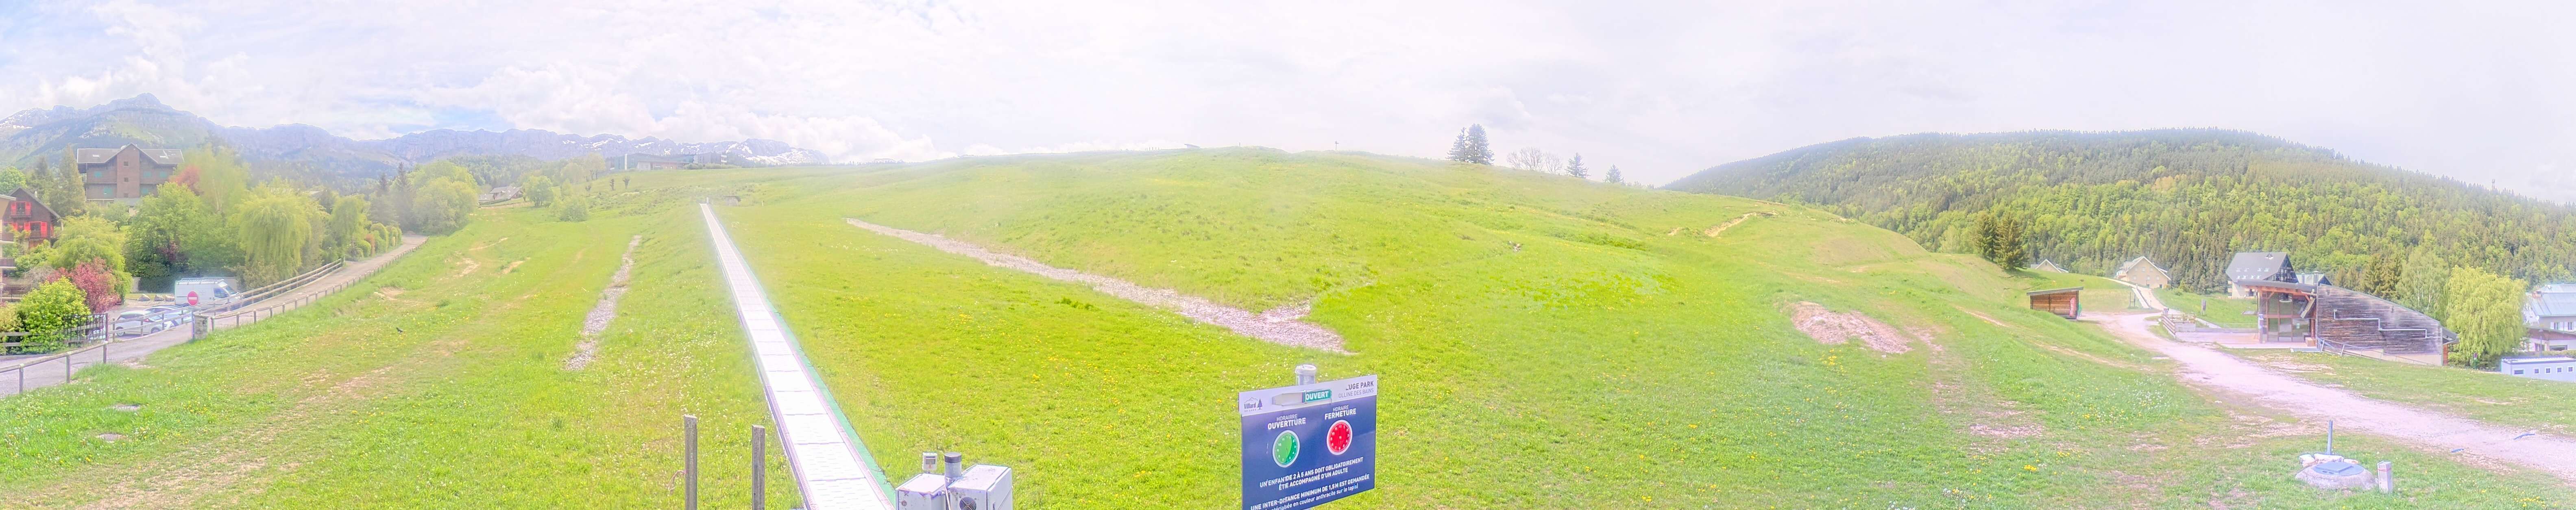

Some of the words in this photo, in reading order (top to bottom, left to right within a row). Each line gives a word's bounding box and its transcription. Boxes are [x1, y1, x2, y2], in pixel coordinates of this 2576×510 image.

[1305, 391, 1329, 400] OUVERT
[1325, 408, 1357, 419] FERMETURE
[1314, 466, 1325, 474] DOIT
[1325, 457, 1364, 471] OBLIGATOIREMENT
[1289, 473, 1321, 487] ACCOMPAGNÉ
[1332, 467, 1348, 476] ADULTE
[1262, 493, 1300, 509] INTER-DISTANCE
[1301, 487, 1321, 498] MINIMUM
[1347, 473, 1370, 485] DEMANDÉE
[1299, 497, 1315, 505] couleur
[1316, 491, 1336, 501] anthracite
